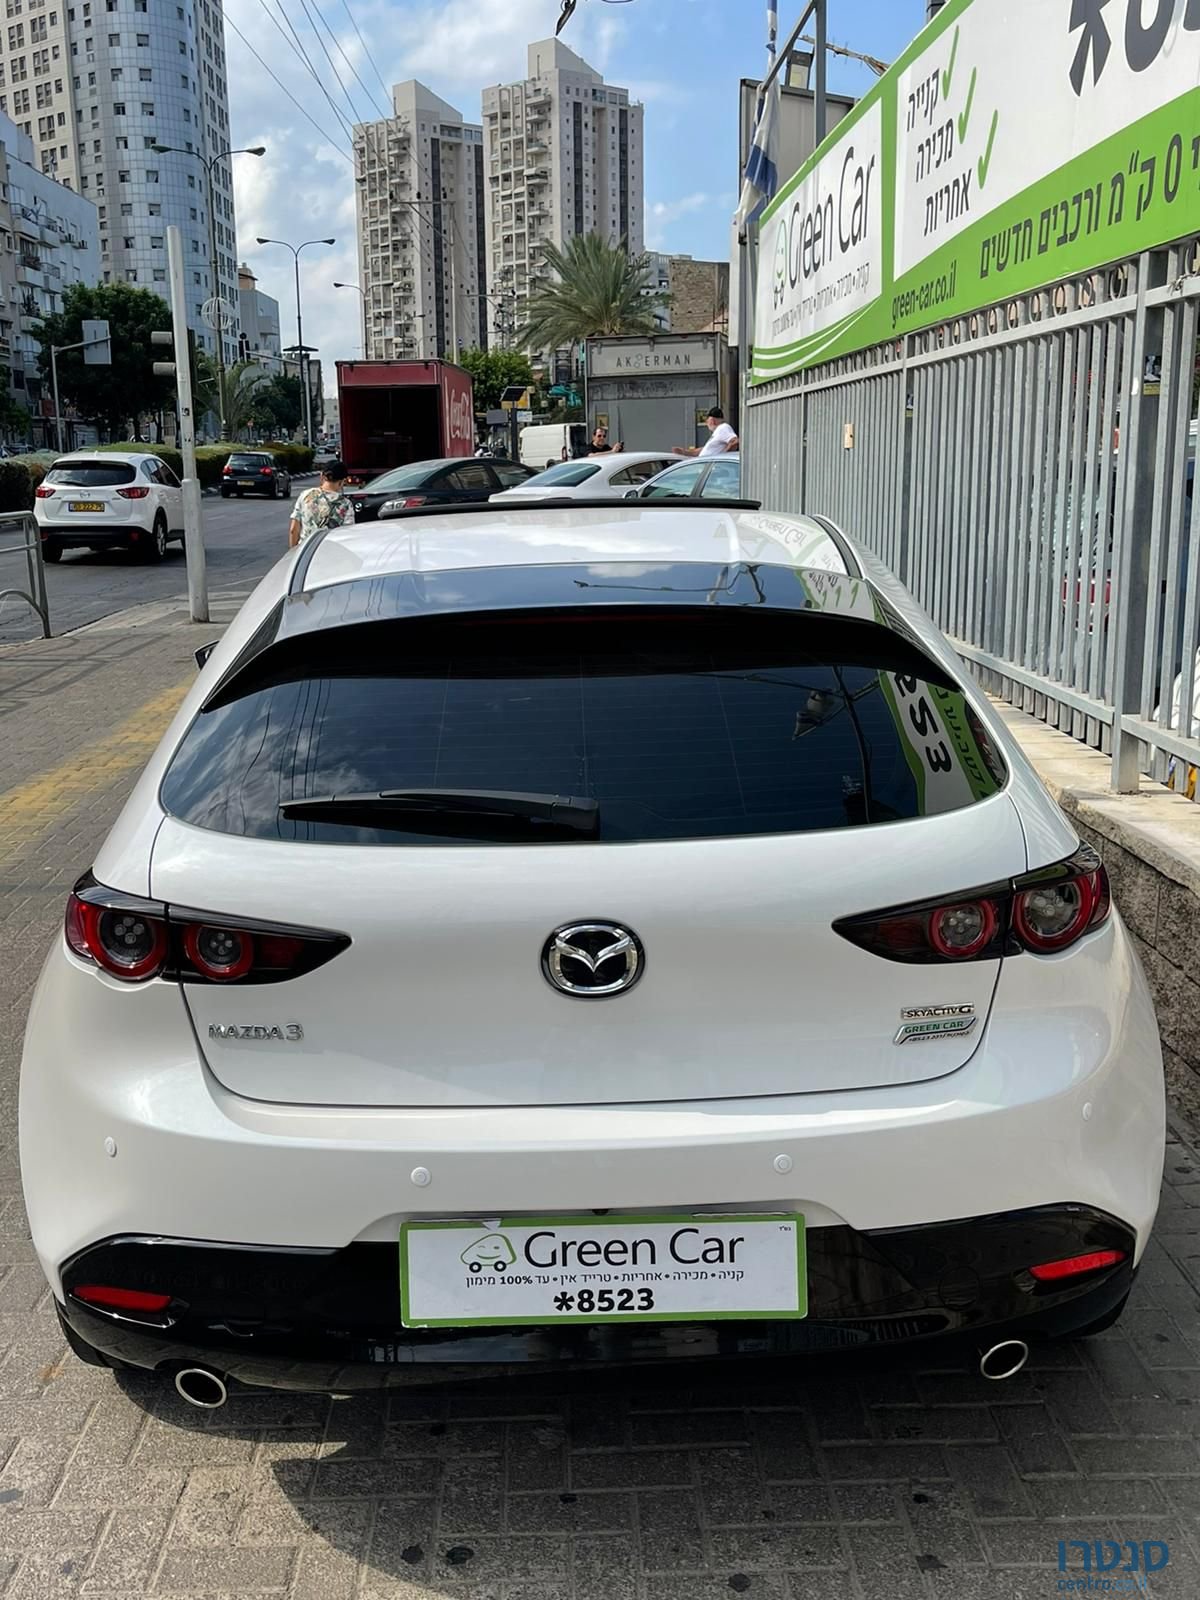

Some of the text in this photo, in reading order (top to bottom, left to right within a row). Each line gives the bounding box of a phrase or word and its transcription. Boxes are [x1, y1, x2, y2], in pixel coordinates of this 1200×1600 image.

[906, 68, 940, 132] קנייה
[916, 118, 954, 183] מכירה
[789, 146, 875, 290] Green Car
[924, 168, 972, 237] אחריות
[1037, 182, 1103, 256] ורכבים
[980, 217, 1033, 279] חדשים
[892, 259, 957, 330] green-car.co.il
[904, 1021, 964, 1034] GREEN CAR
[465, 1270, 745, 1288] קניה מכירה אחריות טרייד אין עד 100% מימון
[523, 1227, 745, 1268] Green Car
